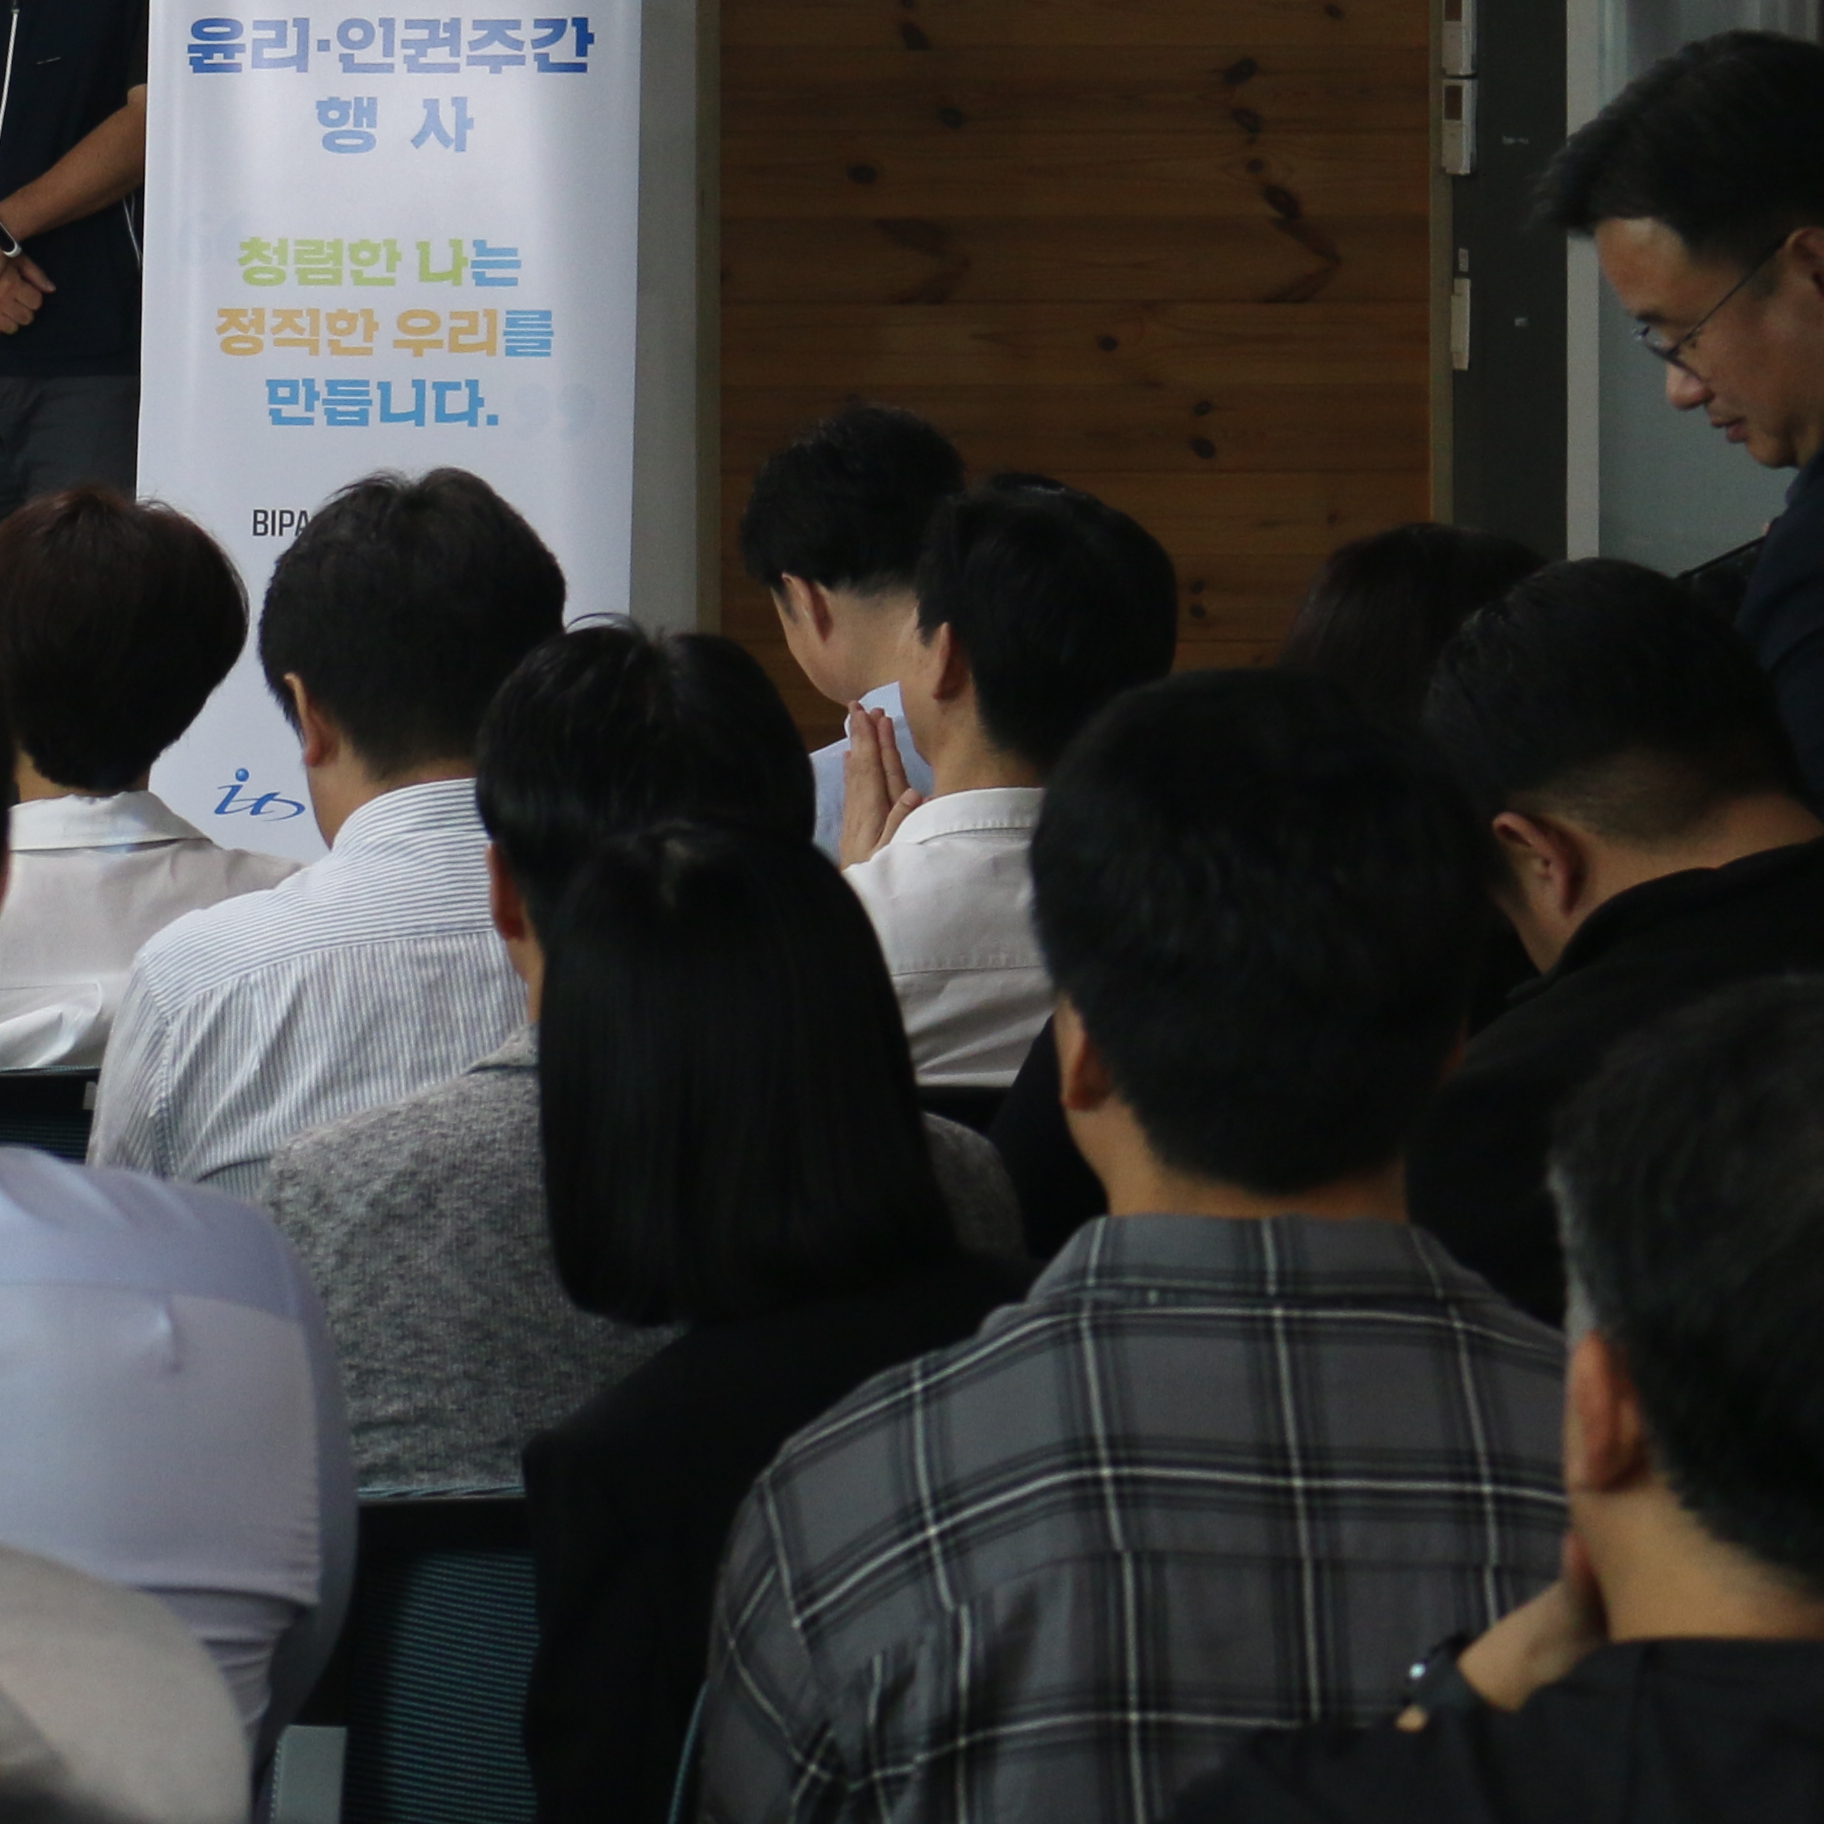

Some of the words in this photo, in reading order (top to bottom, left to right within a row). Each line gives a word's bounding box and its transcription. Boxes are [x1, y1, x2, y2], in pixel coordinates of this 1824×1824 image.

[187, 16, 595, 73] 윤리·인권주간
[237, 238, 402, 287] 청렴한
[415, 238, 521, 287] 나는
[215, 308, 379, 356] 정직한
[392, 308, 554, 357] 우리를
[265, 378, 498, 428] 만듭니다.
